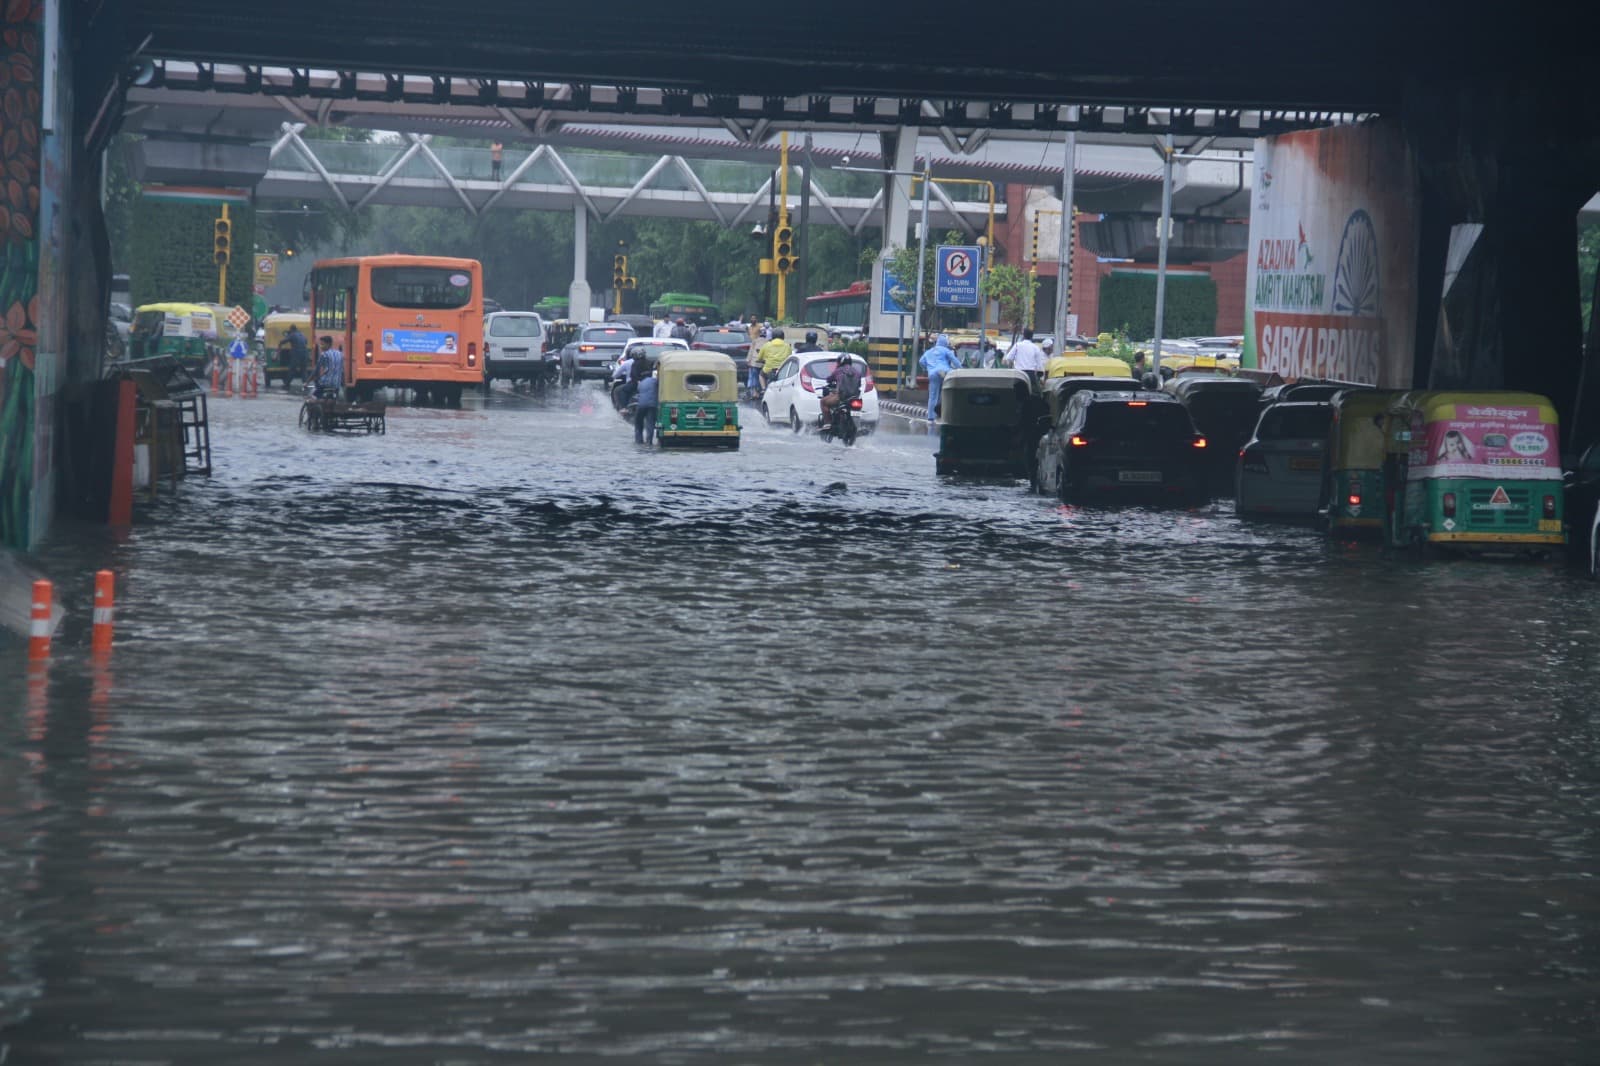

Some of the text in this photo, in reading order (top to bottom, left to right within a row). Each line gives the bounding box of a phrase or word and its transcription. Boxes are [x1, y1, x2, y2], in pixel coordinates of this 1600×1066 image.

[1255, 273, 1325, 306] AMRIT MAHOTSAV
[1262, 325, 1379, 384] SABKA PRAYAS
